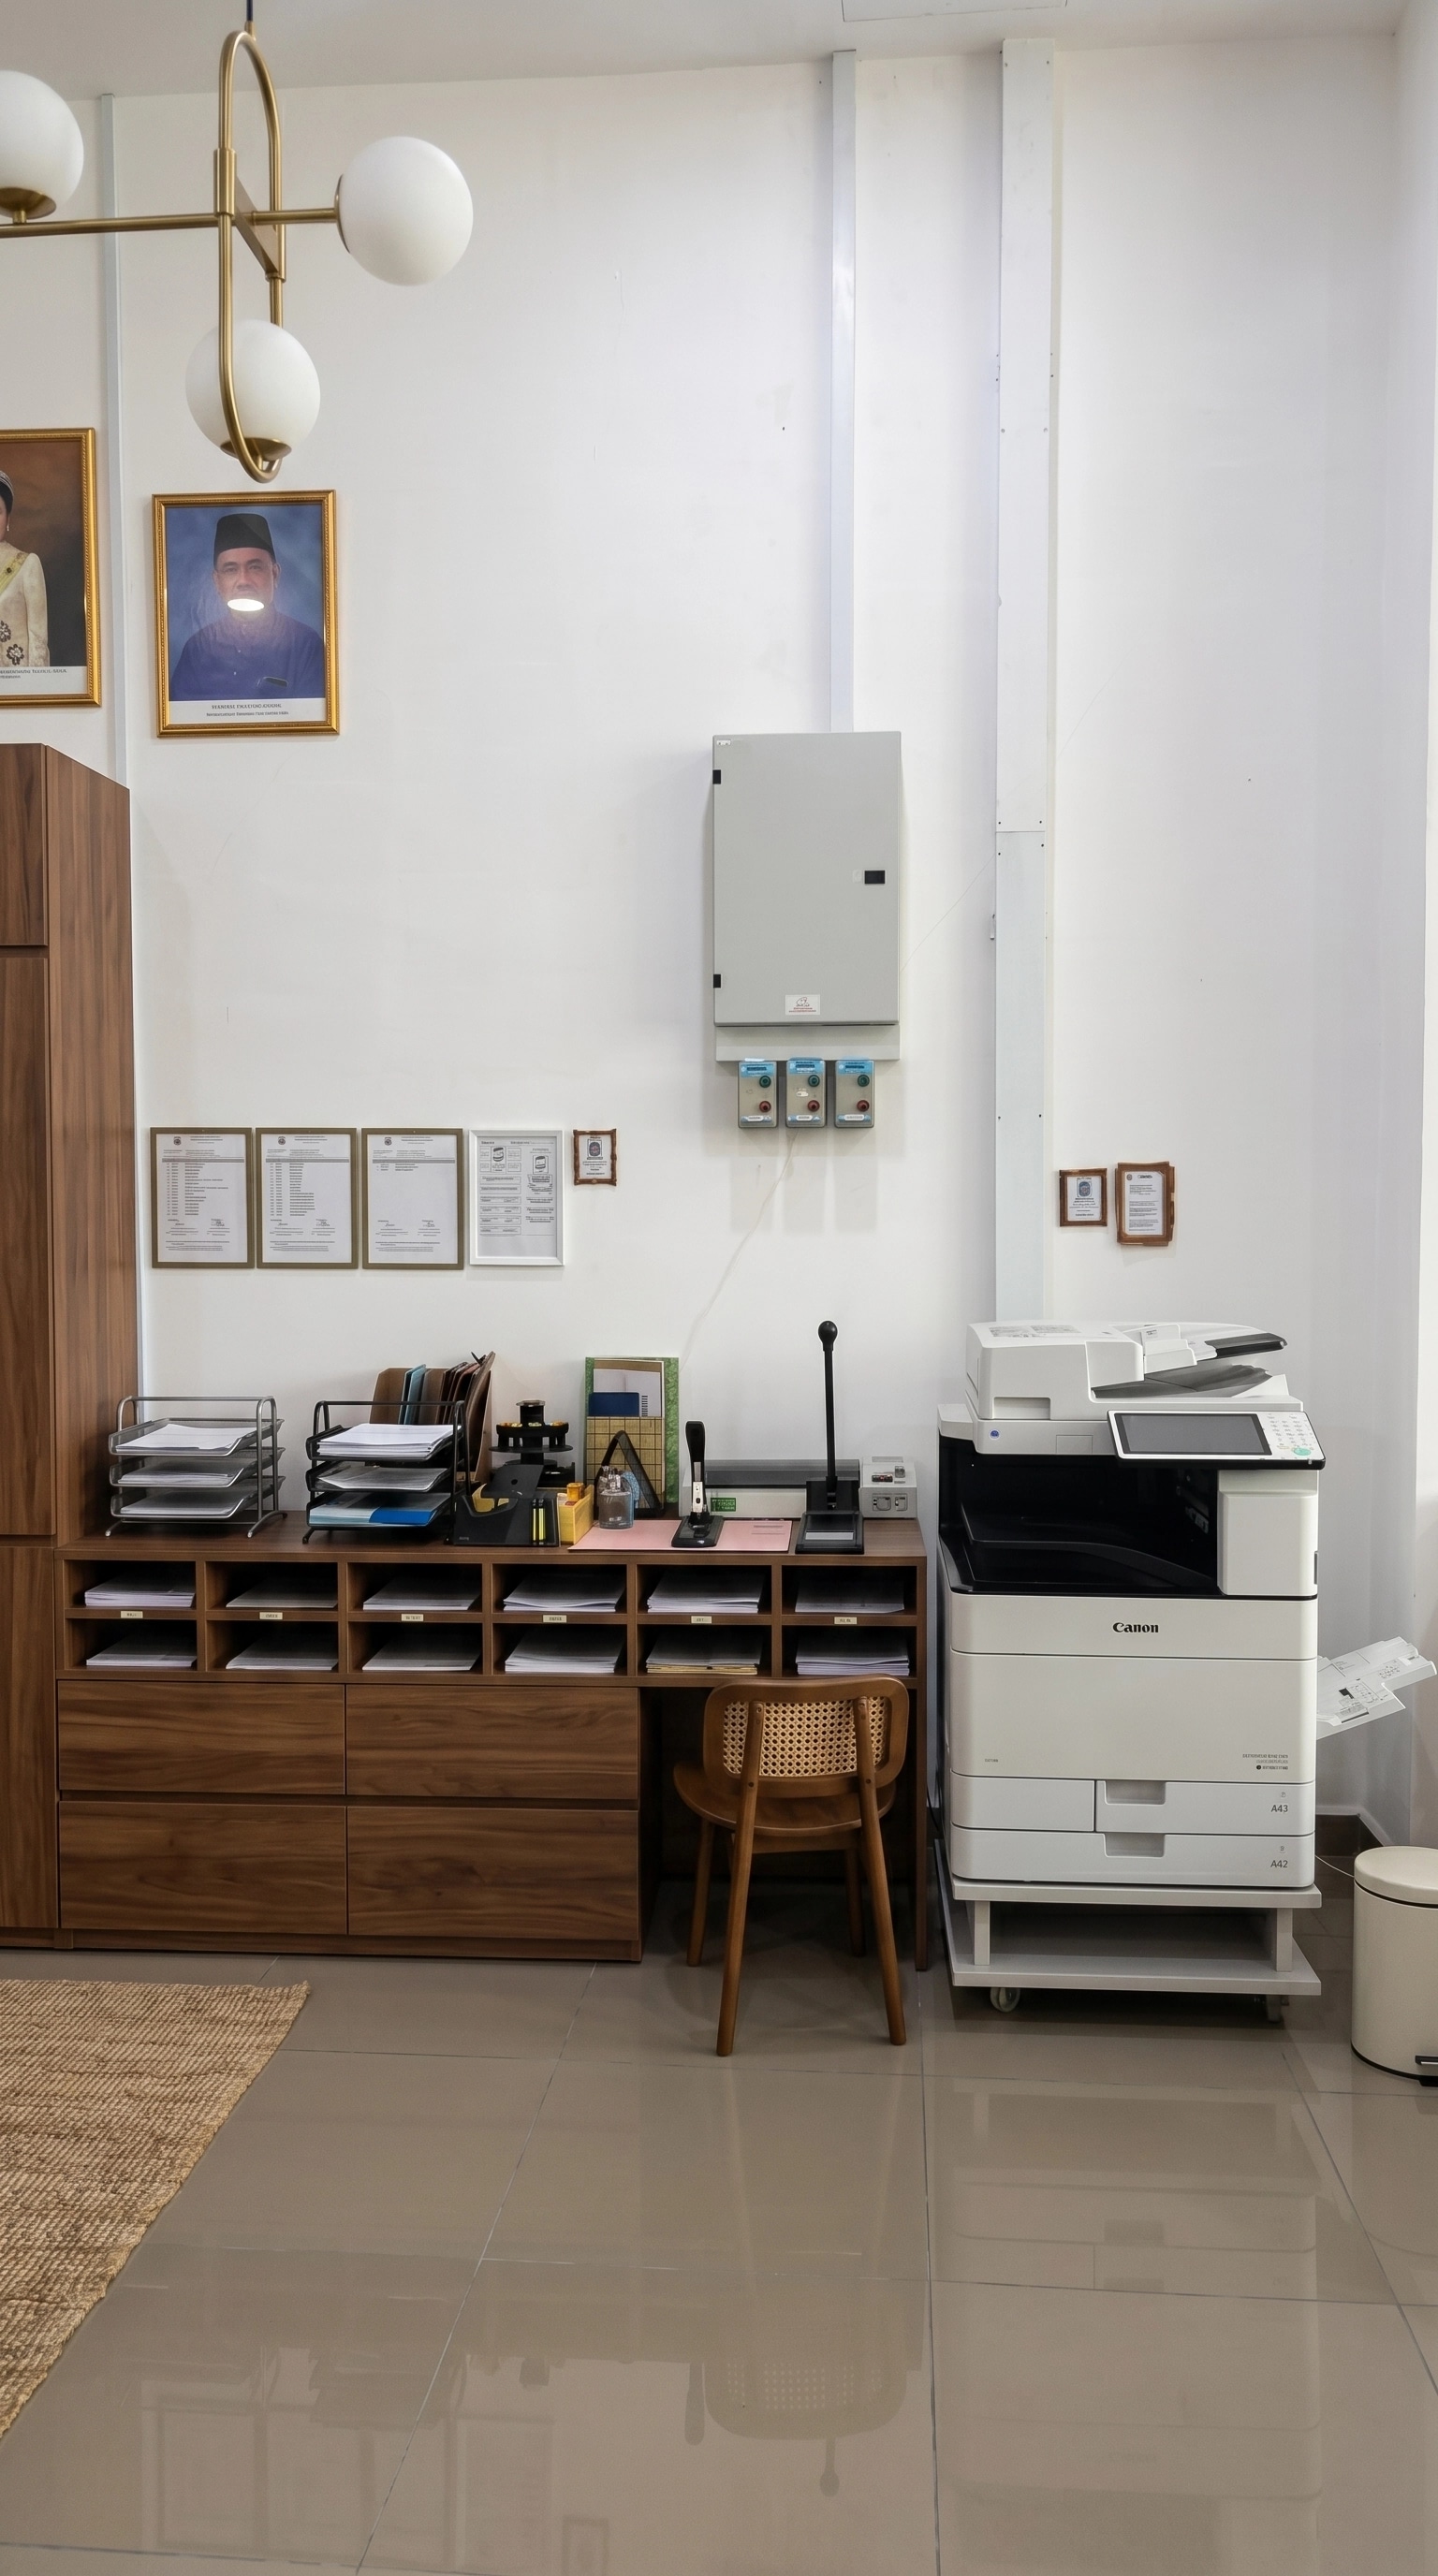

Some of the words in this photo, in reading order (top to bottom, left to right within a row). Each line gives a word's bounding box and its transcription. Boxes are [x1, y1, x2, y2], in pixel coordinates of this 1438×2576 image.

[1112, 1621, 1159, 1633] Canon
[1270, 1804, 1288, 1813] A43
[1270, 1859, 1288, 1868] A42
